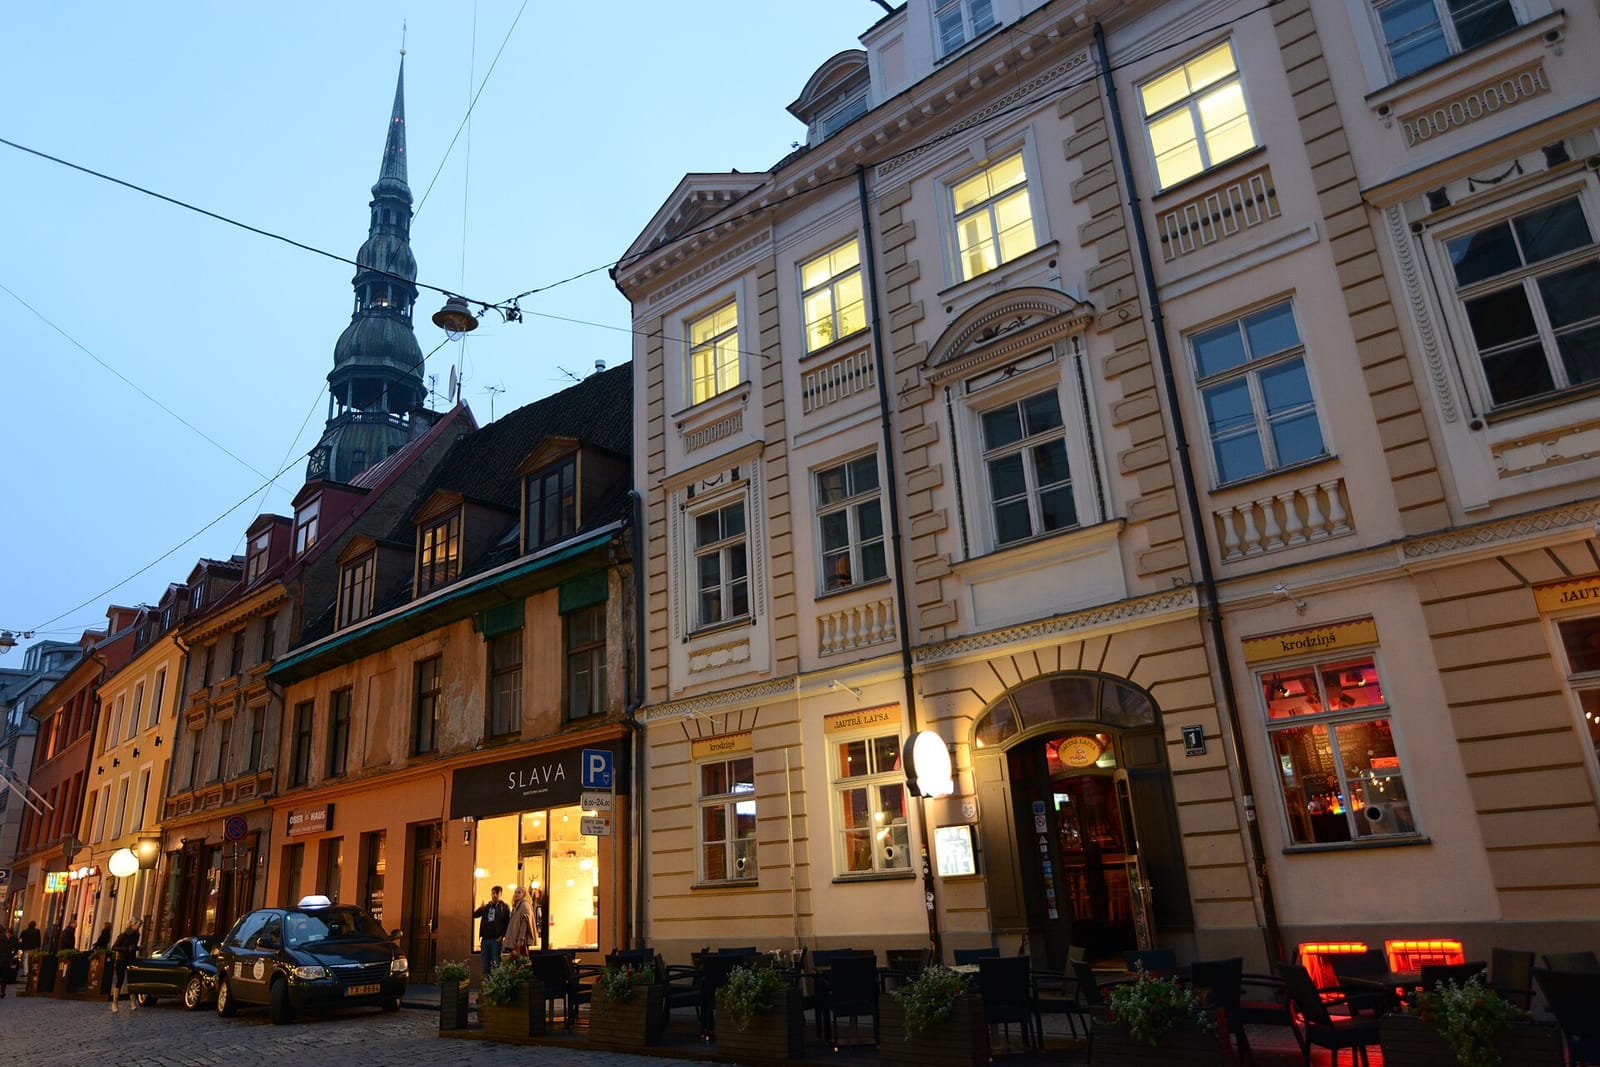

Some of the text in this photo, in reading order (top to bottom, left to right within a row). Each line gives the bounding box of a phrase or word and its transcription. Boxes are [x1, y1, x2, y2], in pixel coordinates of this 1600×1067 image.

[1281, 631, 1336, 651] krodziņš
[864, 713, 889, 724] LAPSA
[1189, 732, 1196, 745] 1
[508, 763, 566, 789] SLAVA
[590, 754, 606, 783] P
